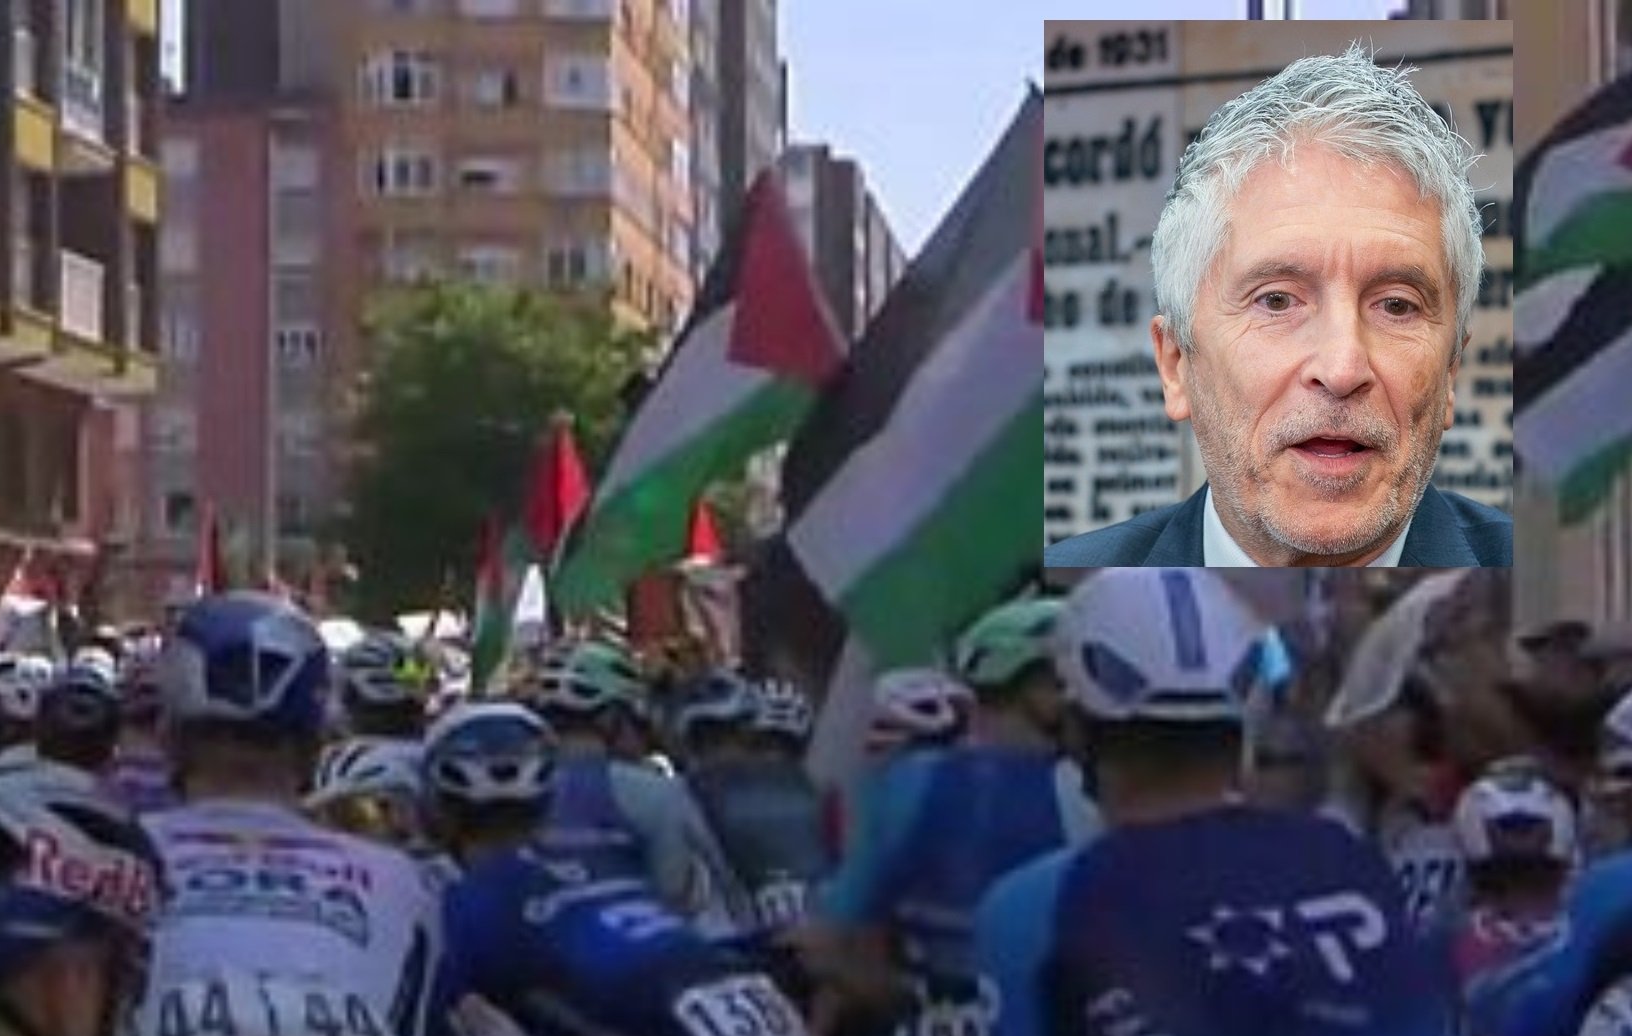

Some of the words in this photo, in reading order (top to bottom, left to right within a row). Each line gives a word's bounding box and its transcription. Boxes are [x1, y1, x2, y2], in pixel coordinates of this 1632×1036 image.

[1048, 36, 1083, 71] de
[1100, 30, 1168, 66] 1931
[1099, 280, 1138, 325] de
